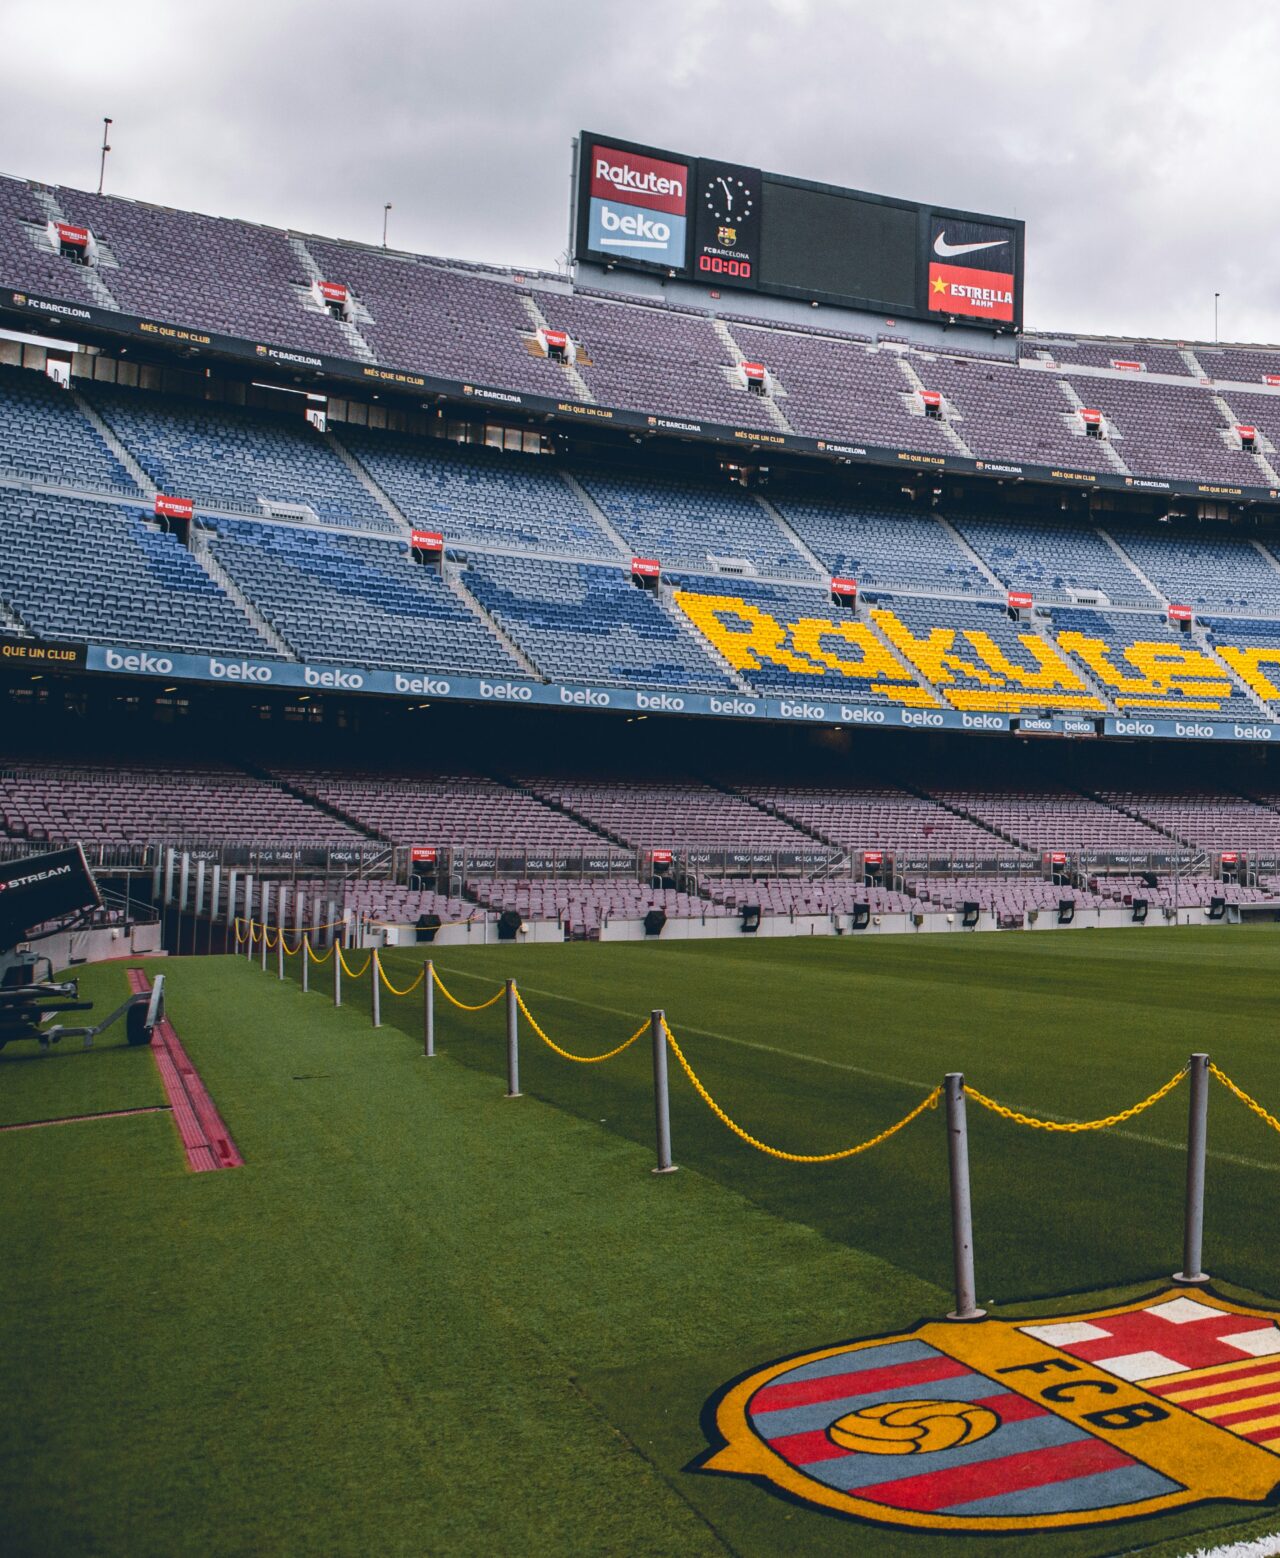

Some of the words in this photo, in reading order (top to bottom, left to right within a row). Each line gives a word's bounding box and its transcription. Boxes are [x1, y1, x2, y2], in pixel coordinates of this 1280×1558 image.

[596, 160, 682, 197] Rakuten
[602, 207, 670, 241] beko
[700, 256, 750, 278] 00:00
[951, 284, 1012, 303] ESTRELLA
[28, 299, 39, 307] FC
[40, 301, 90, 318] BARCELONA
[159, 327, 176, 337] QUE
[177, 331, 189, 339] UN
[190, 334, 210, 344] CLUB
[279, 351, 322, 366] BARCELONA
[380, 372, 394, 380] QUE
[407, 377, 424, 385] CLUB
[484, 390, 521, 403] BARCELONA
[666, 421, 700, 431] BARCELONA
[3, 646, 26, 657] QUE
[29, 648, 44, 658] UN
[48, 650, 76, 660] CLUB
[106, 650, 172, 673] beko
[210, 659, 272, 682] beko
[304, 667, 363, 689] beko
[395, 674, 450, 695] beko
[480, 681, 532, 700] beko
[560, 687, 609, 706] beko
[637, 693, 684, 710] beko
[710, 698, 756, 715] beko
[780, 702, 824, 719] beko
[841, 706, 884, 723] beko
[902, 709, 943, 726] beko
[962, 713, 1002, 729] beko
[1024, 719, 1051, 730] beko
[1064, 721, 1090, 731] beko
[1116, 720, 1154, 734] beko
[1176, 723, 1213, 737] beko
[1234, 725, 1271, 739] beko
[8, 865, 71, 888] STREAM
[995, 1358, 1170, 1430] FCB
